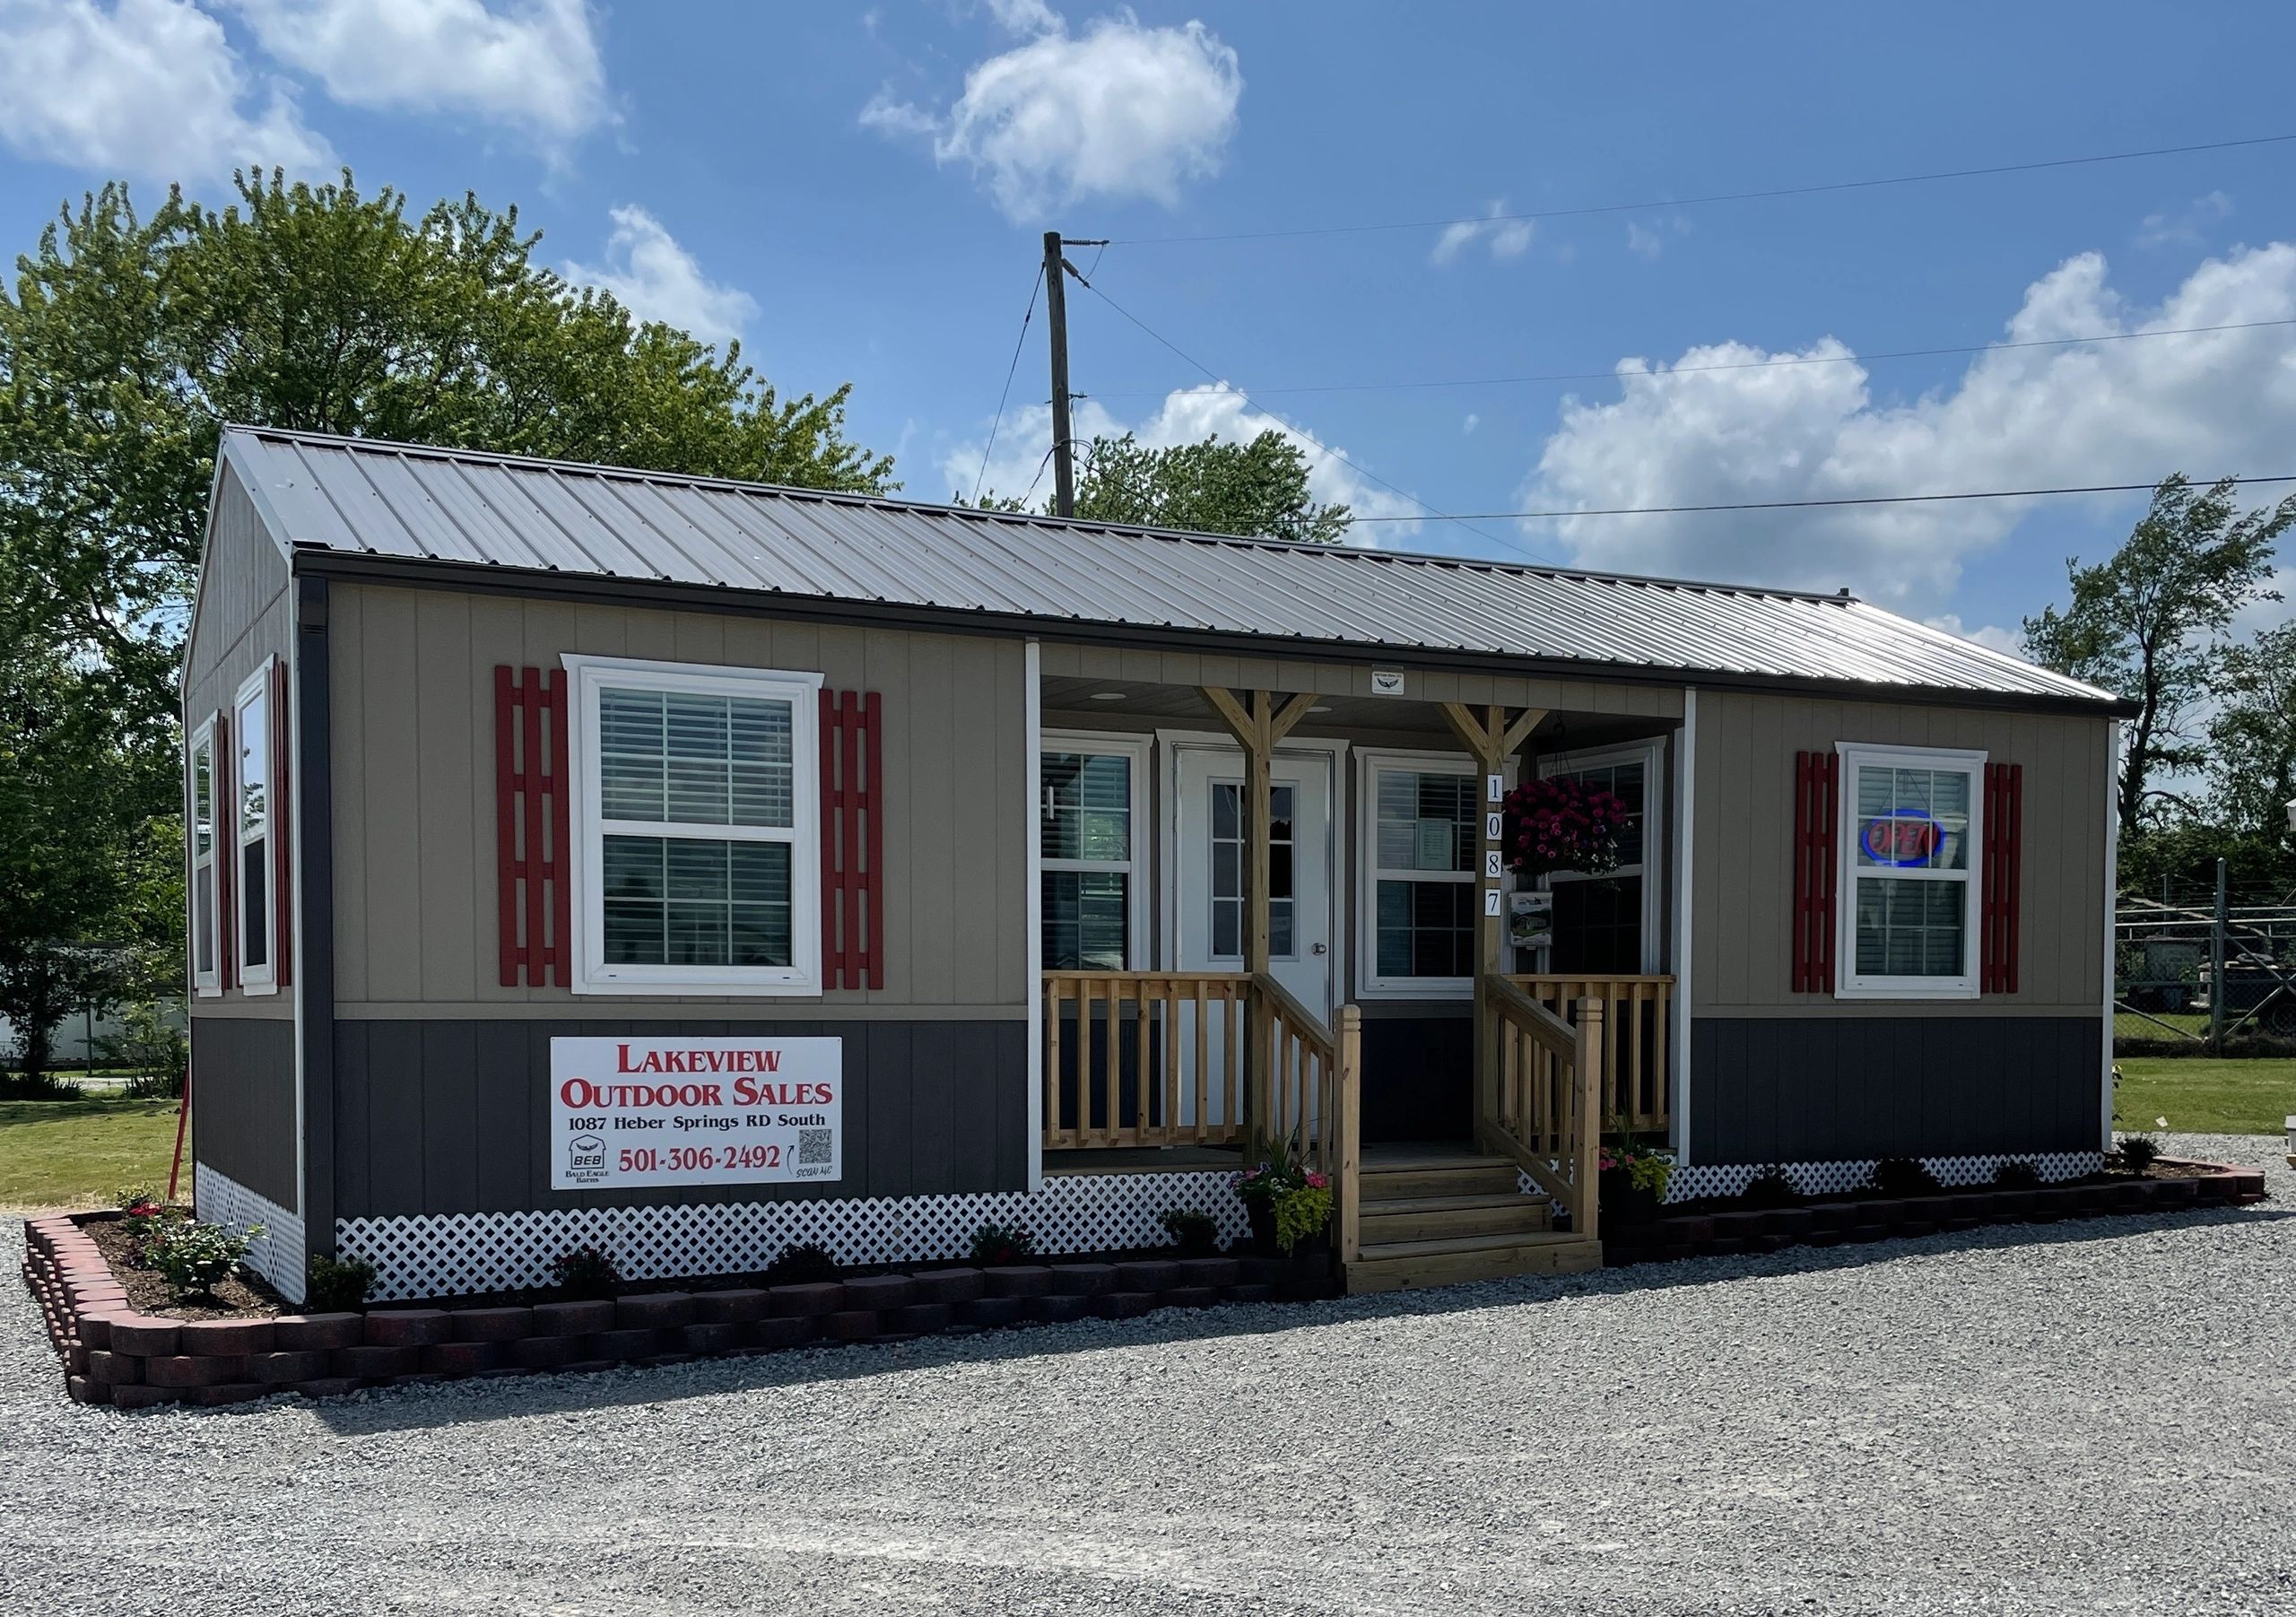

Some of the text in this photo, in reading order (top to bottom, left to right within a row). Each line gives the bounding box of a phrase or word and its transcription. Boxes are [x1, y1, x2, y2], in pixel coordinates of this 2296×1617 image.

[1868, 822, 1939, 856] OPEN
[616, 1044, 781, 1074] LAKEVIEW
[561, 1077, 833, 1108] OUTDOOR SALES
[569, 1113, 826, 1132] 1087 Heber Springs RD South
[574, 1155, 602, 1166] BEB
[619, 1144, 780, 1172] 501-306-2492
[796, 1165, 833, 1178] SCAN ME
